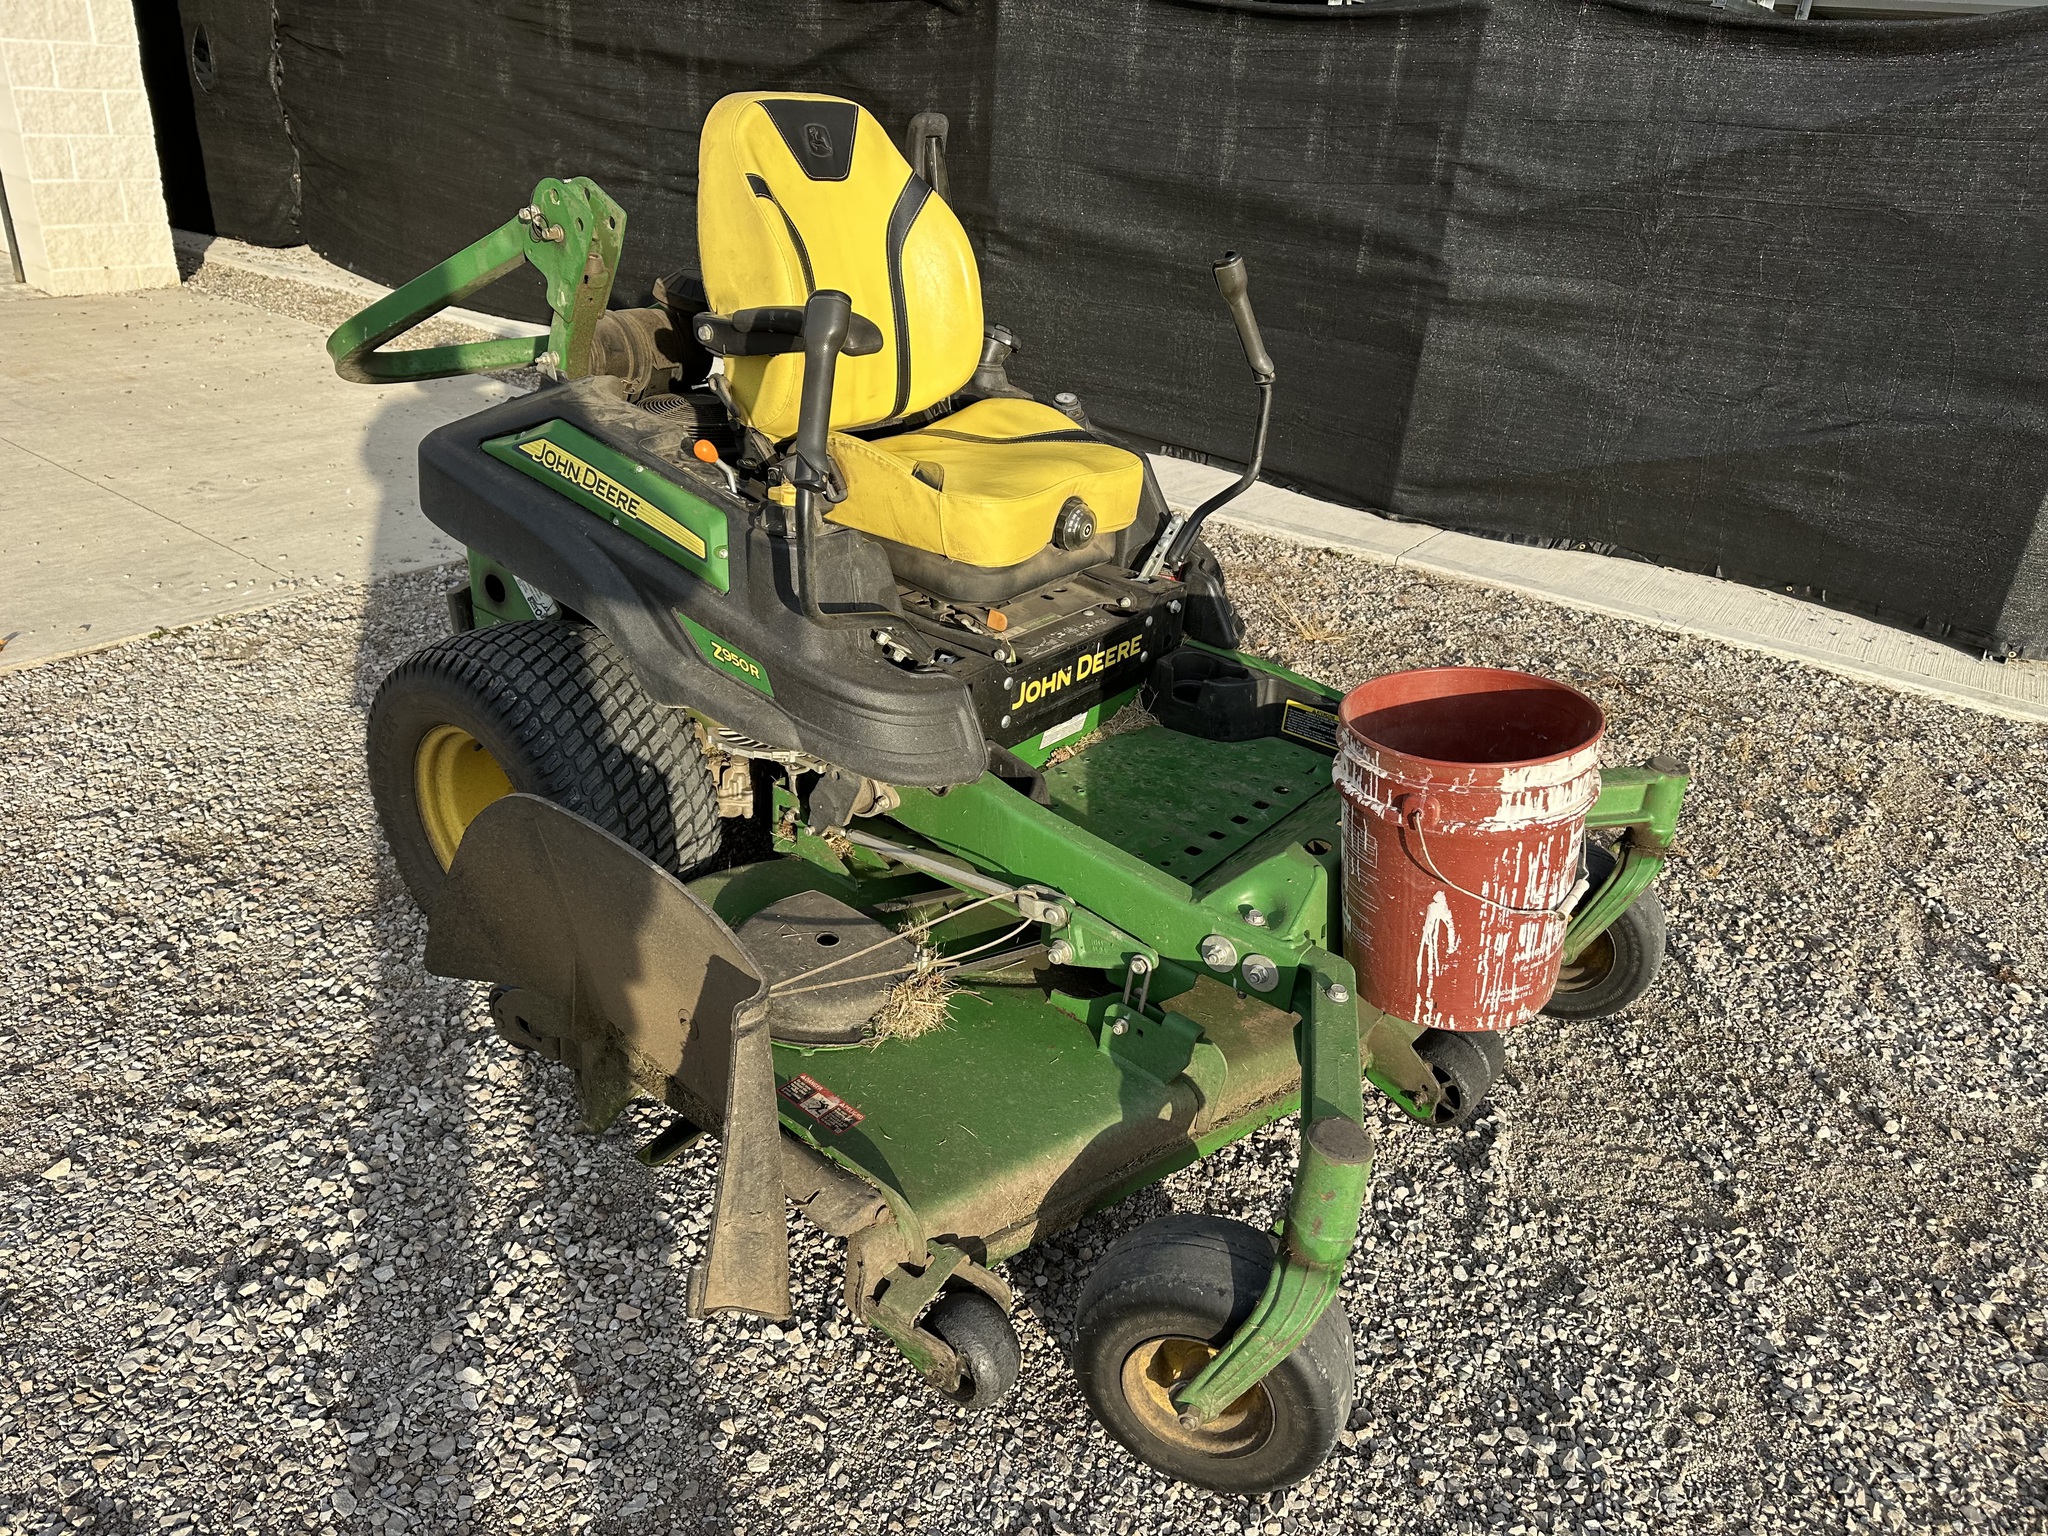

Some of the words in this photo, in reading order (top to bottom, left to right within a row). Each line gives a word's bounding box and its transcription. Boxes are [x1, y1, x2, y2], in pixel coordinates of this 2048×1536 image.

[535, 443, 581, 482] JOHN
[582, 469, 640, 517] DEERE
[710, 640, 761, 681] Z950R
[1012, 666, 1072, 710] JOHN
[1076, 634, 1143, 682] DEERE
